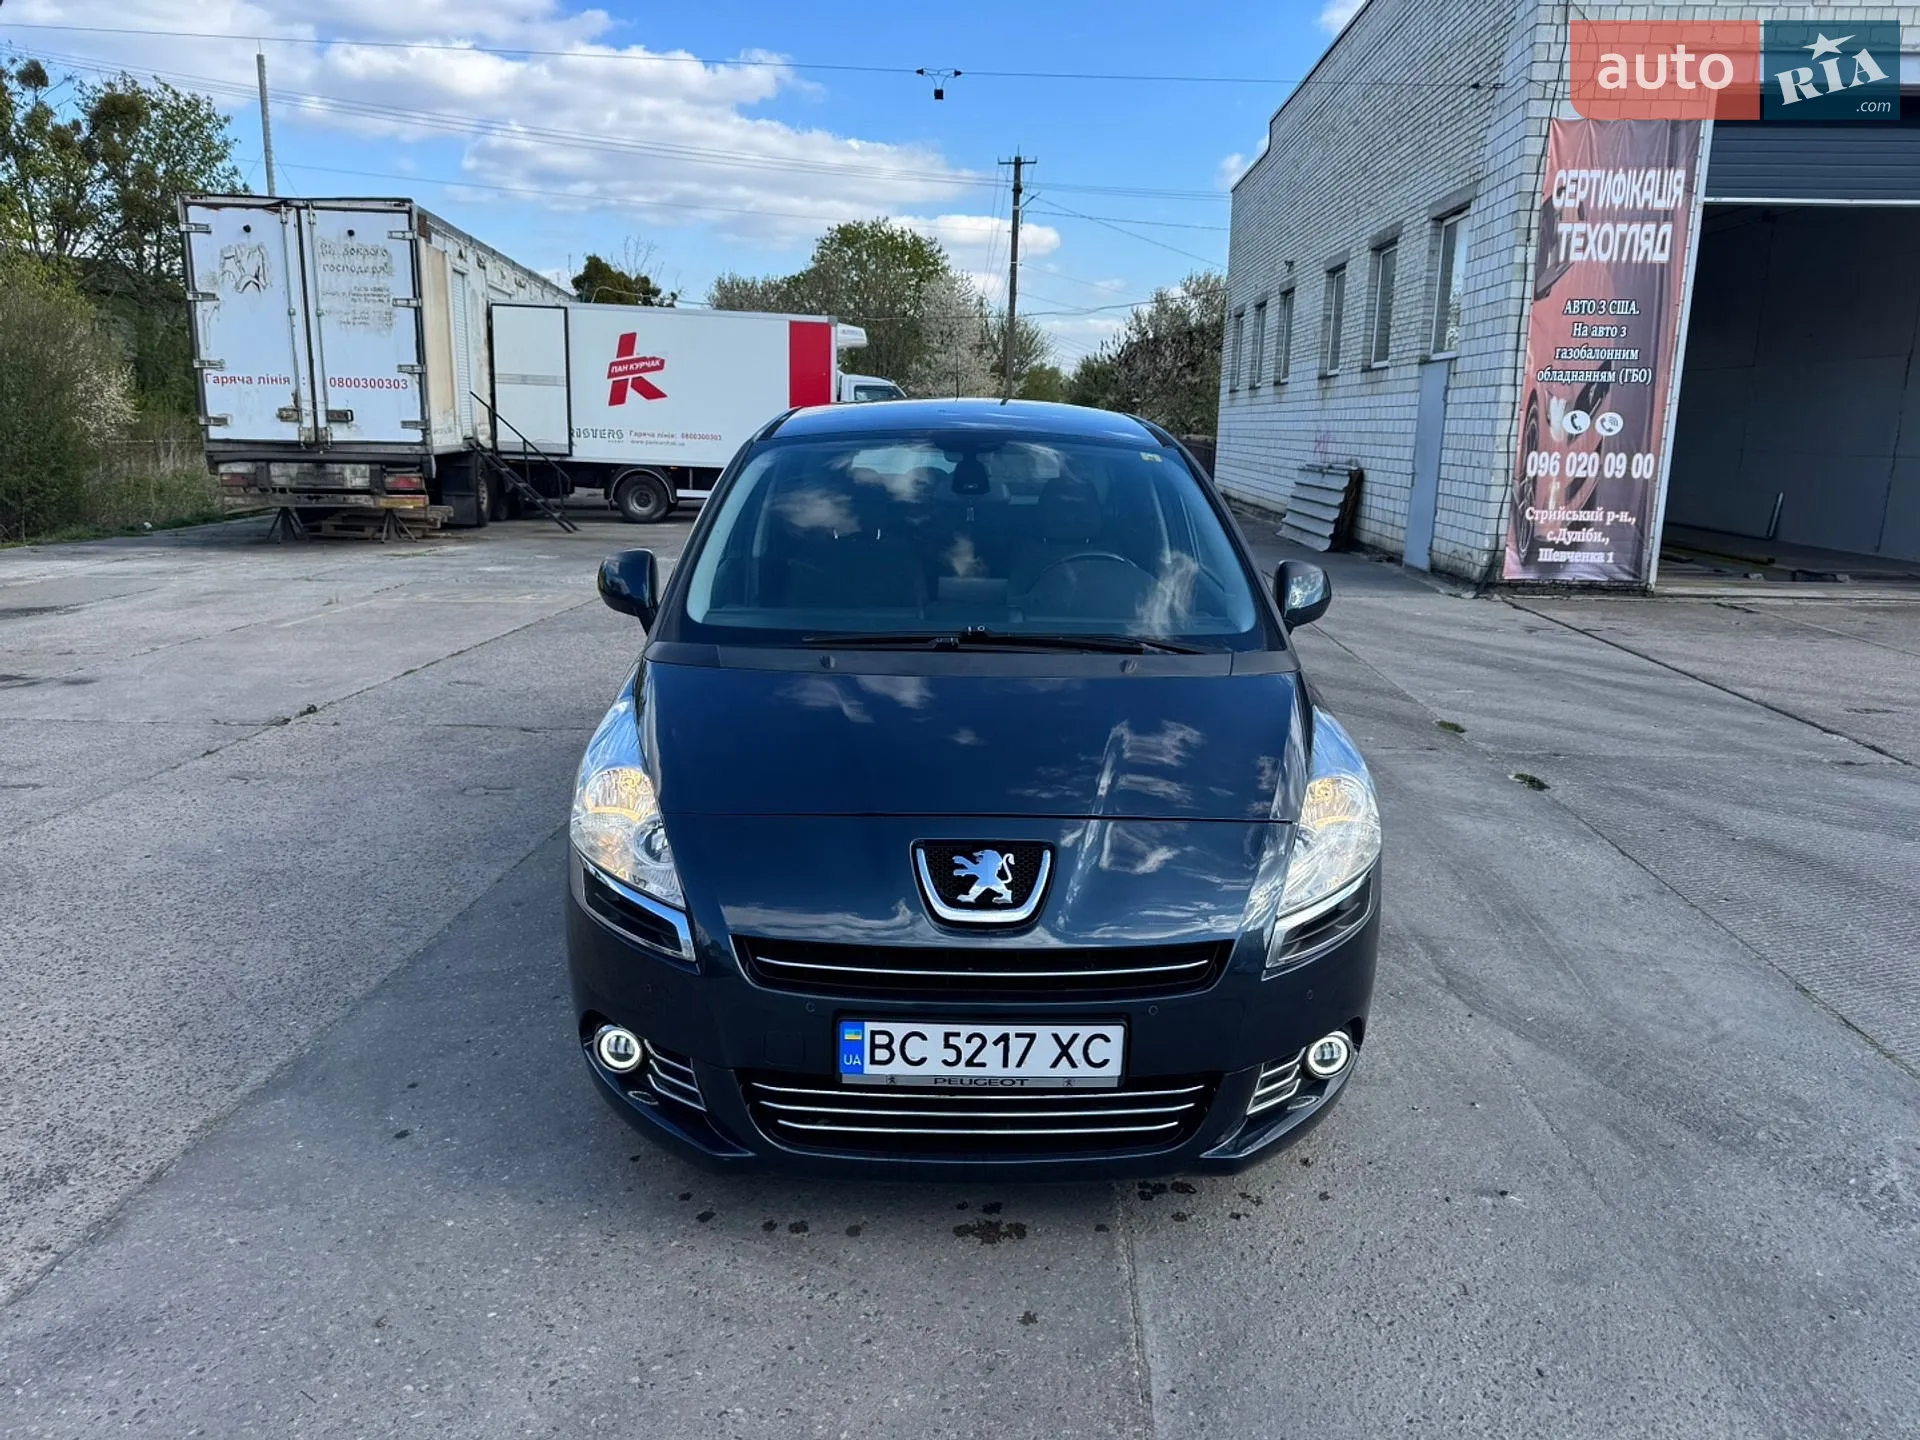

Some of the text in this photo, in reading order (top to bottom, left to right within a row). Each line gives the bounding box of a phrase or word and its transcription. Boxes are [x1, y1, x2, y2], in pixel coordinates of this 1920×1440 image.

[1552, 168, 1686, 210] СЕРТИФІКАЦІЯ
[1557, 221, 1673, 263] ТЕХОГЛЯД
[1563, 300, 1595, 315] АВТО
[1609, 300, 1640, 315] США.
[1571, 322, 1588, 337] На
[1591, 326, 1618, 337] авто
[1555, 343, 1639, 360] газобалонним
[611, 360, 660, 373] ПАН КУРЧАК
[1537, 366, 1652, 384] обладнанням (ГБО)
[205, 373, 253, 387] Гаряча
[257, 373, 290, 385] лінія
[329, 376, 408, 390] 0800300303
[1526, 451, 1655, 479] 096 020 09 00
[1525, 506, 1604, 524] Стрийський
[1607, 551, 1614, 563] 1
[868, 1030, 1112, 1069] BC 5217 XC
[844, 1055, 862, 1066] UA
[933, 1078, 1030, 1087] PEUGEOT
